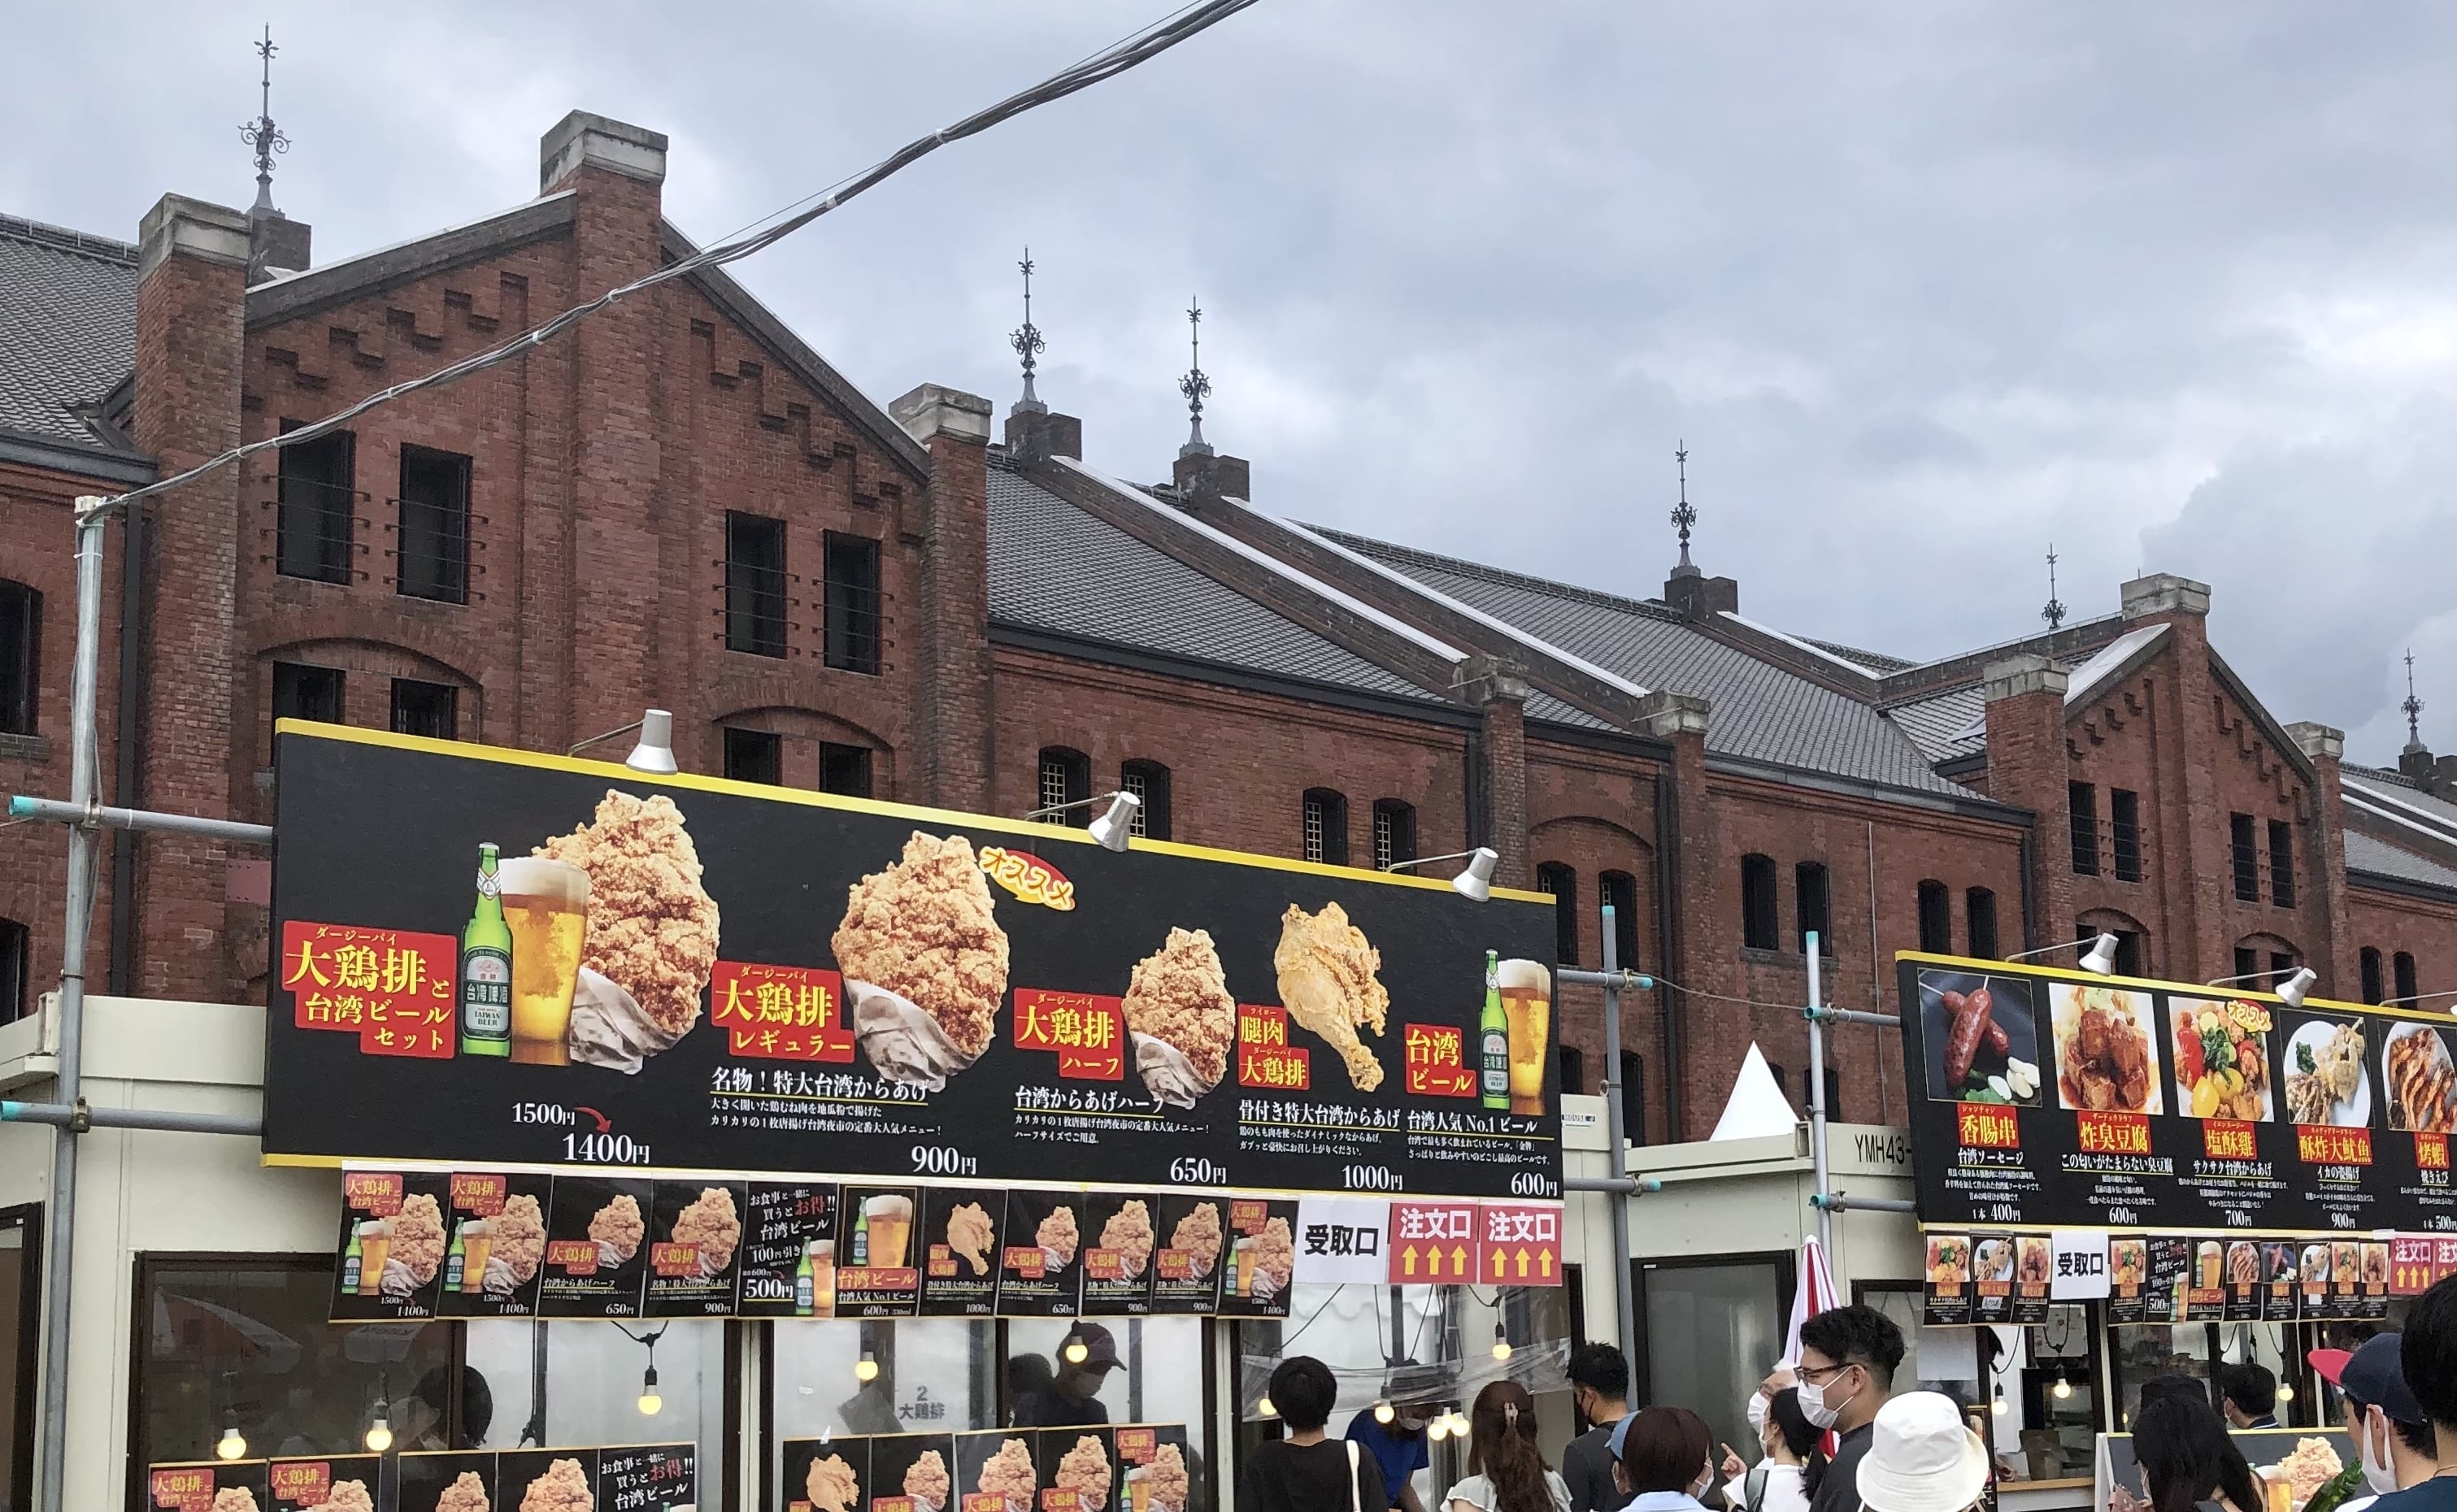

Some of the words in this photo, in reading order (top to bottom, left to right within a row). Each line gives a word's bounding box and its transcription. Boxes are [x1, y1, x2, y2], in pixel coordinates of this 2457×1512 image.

[981, 849, 1073, 908] オススメ
[305, 993, 452, 1027] 台湾ビール
[715, 980, 833, 1028] 大鶏排
[2229, 1001, 2272, 1029] オススメ
[374, 1027, 444, 1053] セット
[1016, 1006, 1115, 1049] 大鶏排
[1240, 1016, 1283, 1045] 腿肉
[736, 1030, 852, 1056] レギュラー
[1407, 1028, 1459, 1067] 台湾
[1063, 1058, 1119, 1075] ハーフ
[1240, 1055, 1306, 1086] 大鶏排
[1413, 1068, 1473, 1093] ビール
[1015, 1085, 1164, 1114] 台湾からあげハーフ
[511, 1102, 576, 1127] 1500円
[1239, 1099, 1401, 1128] 骨付き特大台湾からあげ
[1407, 1110, 1463, 1132] 台湾人気
[1466, 1114, 1495, 1132] No.1
[1500, 1118, 1537, 1133] ビール
[1960, 1114, 2016, 1145] 香腸串
[2081, 1122, 2148, 1152] 炸臭豆腐
[563, 1133, 650, 1165] 1400円
[911, 1145, 977, 1175] 900円
[1958, 1147, 2023, 1165] 台湾ソーセージ
[1170, 1158, 1226, 1184] 650円
[2062, 1154, 2172, 1172] この匂いがたまらない臭豆腐
[2194, 1160, 2272, 1176] サクサク台湾からあげ
[1342, 1165, 1402, 1190] 1000円
[1511, 1172, 1557, 1197] 600円
[1399, 1207, 1471, 1240] 注文口
[1972, 1208, 1986, 1220] 1本
[1991, 1204, 2020, 1222] 400円
[2109, 1207, 2137, 1224] 600円
[2225, 1210, 2252, 1226] 700円
[2332, 1213, 2355, 1228] 900円
[761, 1219, 829, 1241] 台湾ビール
[1489, 1210, 1555, 1242] 注文口
[1304, 1224, 1379, 1257] 受取口
[2395, 1241, 2431, 1263] 注文口
[2058, 1253, 2103, 1277] 受取口
[745, 1279, 794, 1298] 500円
[838, 1270, 915, 1288] 台湾ビール
[606, 1304, 634, 1314] 650円
[705, 1303, 731, 1314] 900円
[863, 1306, 889, 1315] 600円
[966, 1304, 990, 1314] 1000円
[1052, 1304, 1074, 1314] 650円
[1128, 1303, 1147, 1312] 900円
[1194, 1303, 1213, 1312] 900円
[2148, 1298, 2170, 1310] 500円
[916, 1385, 928, 1401] 2
[615, 1482, 688, 1510] 台湾ビール
